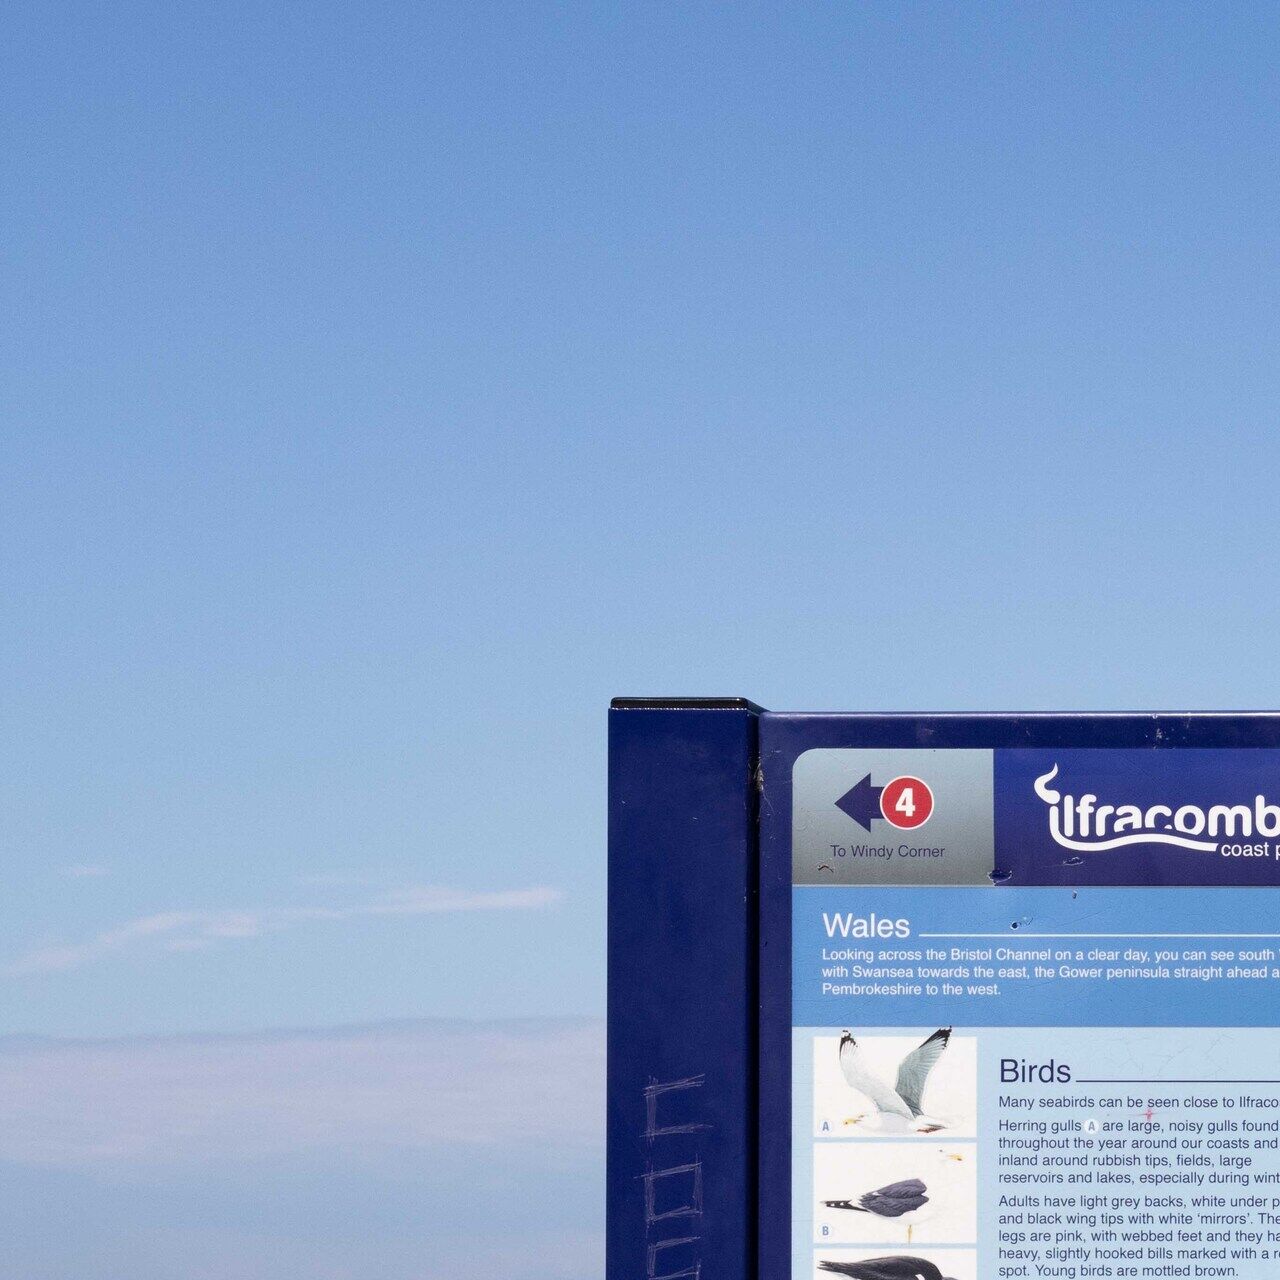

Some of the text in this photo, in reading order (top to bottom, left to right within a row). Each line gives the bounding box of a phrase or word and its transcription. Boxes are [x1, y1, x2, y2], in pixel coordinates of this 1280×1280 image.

[894, 787, 916, 818] 4
[829, 844, 946, 861] To Windy Corner
[1220, 841, 1270, 857] coast
[822, 912, 911, 939] Wales
[822, 982, 1001, 999] Pembrokeshire to the west.
[1000, 1058, 1072, 1084] Birds
[999, 1095, 1035, 1111] Many
[1038, 1095, 1095, 1108] seabirds
[1098, 1098, 1123, 1108] can
[1126, 1095, 1144, 1108] be
[1147, 1098, 1180, 1108] seen
[1183, 1096, 1219, 1108] close
[1222, 1096, 1235, 1108] to
[822, 1120, 830, 1132] A
[822, 1225, 829, 1236] B
